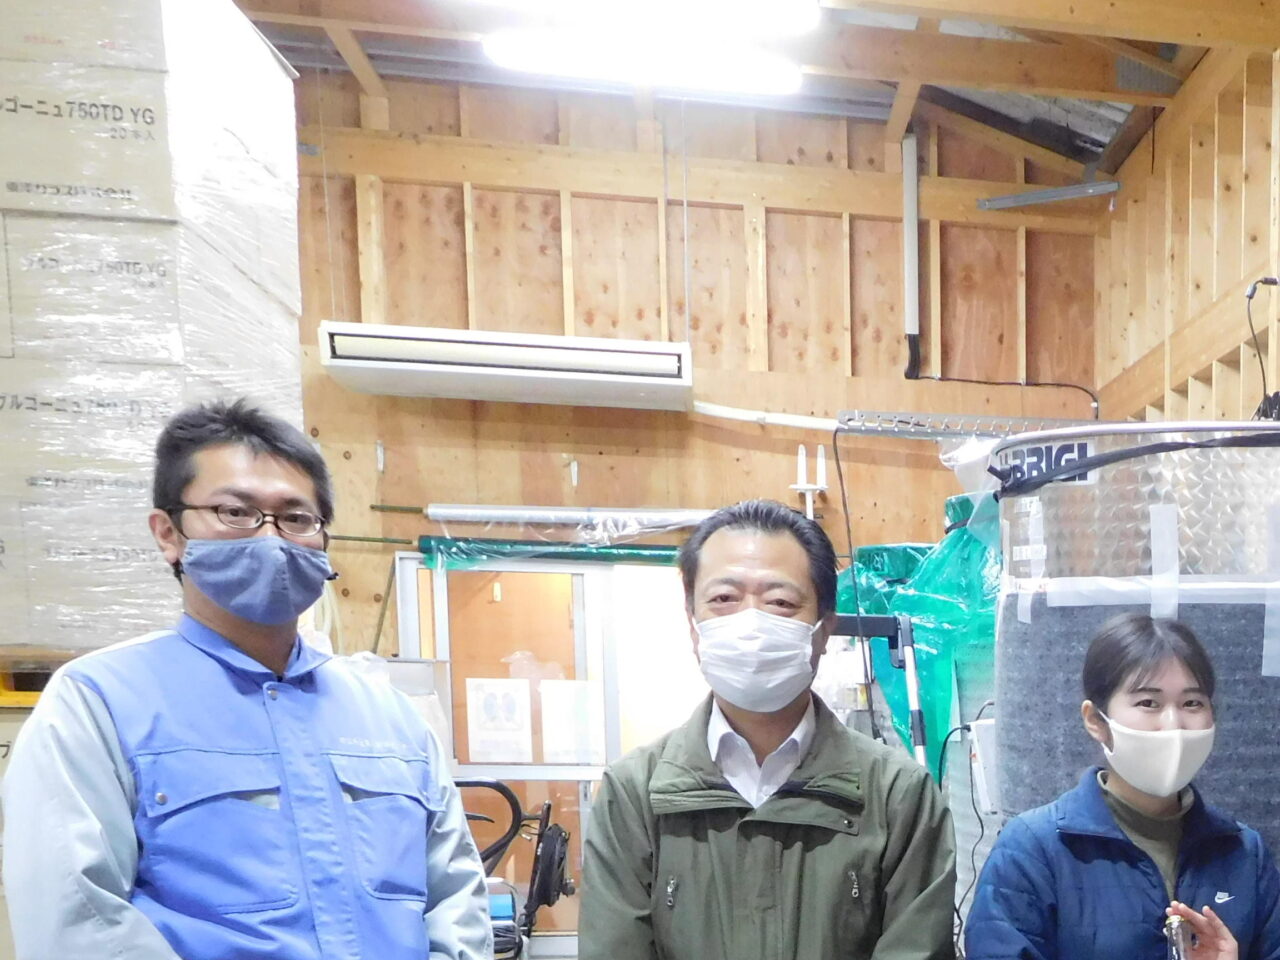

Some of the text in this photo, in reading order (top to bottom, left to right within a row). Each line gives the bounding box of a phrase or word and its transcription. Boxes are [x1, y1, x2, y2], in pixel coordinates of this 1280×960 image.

[0, 96, 155, 125] ゴーニュ750TD YG
[1000, 443, 1087, 480] BRIGI
